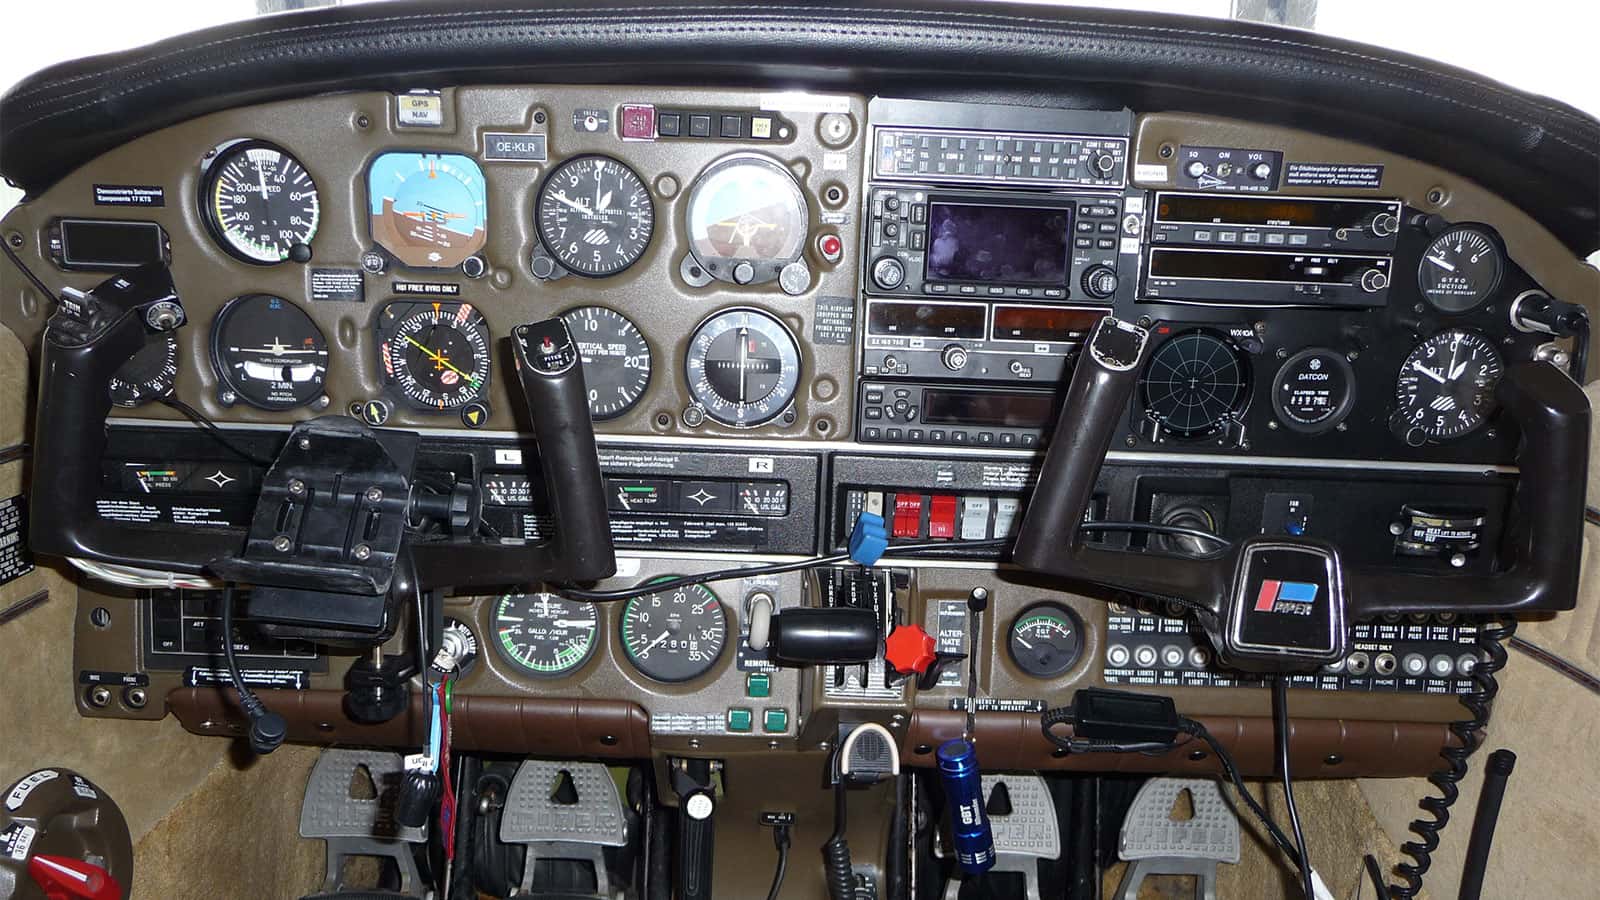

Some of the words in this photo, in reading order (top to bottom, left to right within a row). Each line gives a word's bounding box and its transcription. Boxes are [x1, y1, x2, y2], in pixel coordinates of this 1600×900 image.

[497, 143, 535, 151] OE-KLR
[274, 174, 286, 183] 40
[594, 169, 602, 181] 0
[570, 175, 579, 187] 9
[236, 183, 252, 192] 200
[233, 195, 247, 204] 180
[289, 193, 301, 201] 60
[629, 196, 638, 207] 2
[290, 216, 302, 225] 80
[279, 231, 293, 239] 100
[560, 227, 567, 239] 7
[629, 227, 638, 239] 3
[569, 242, 578, 254] 6
[615, 244, 625, 256] 4
[1454, 245, 1463, 254] 4
[593, 250, 602, 262] 5
[1439, 250, 1446, 260] 2
[1471, 254, 1478, 264] 6
[584, 319, 598, 331] 10
[1427, 347, 1436, 358] 9
[624, 356, 639, 368] 20
[1480, 364, 1488, 376] 2
[1408, 394, 1416, 406] 7
[1416, 408, 1424, 419] 6
[1459, 410, 1467, 421] 4
[1436, 415, 1444, 427] 5
[652, 597, 661, 607] 15
[673, 592, 686, 603] 20
[691, 604, 704, 614] 25
[640, 612, 649, 622] 10
[641, 634, 648, 644] 5
[941, 639, 960, 647] NATE
[688, 651, 701, 661] 35
[12, 773, 52, 800] FUEL
